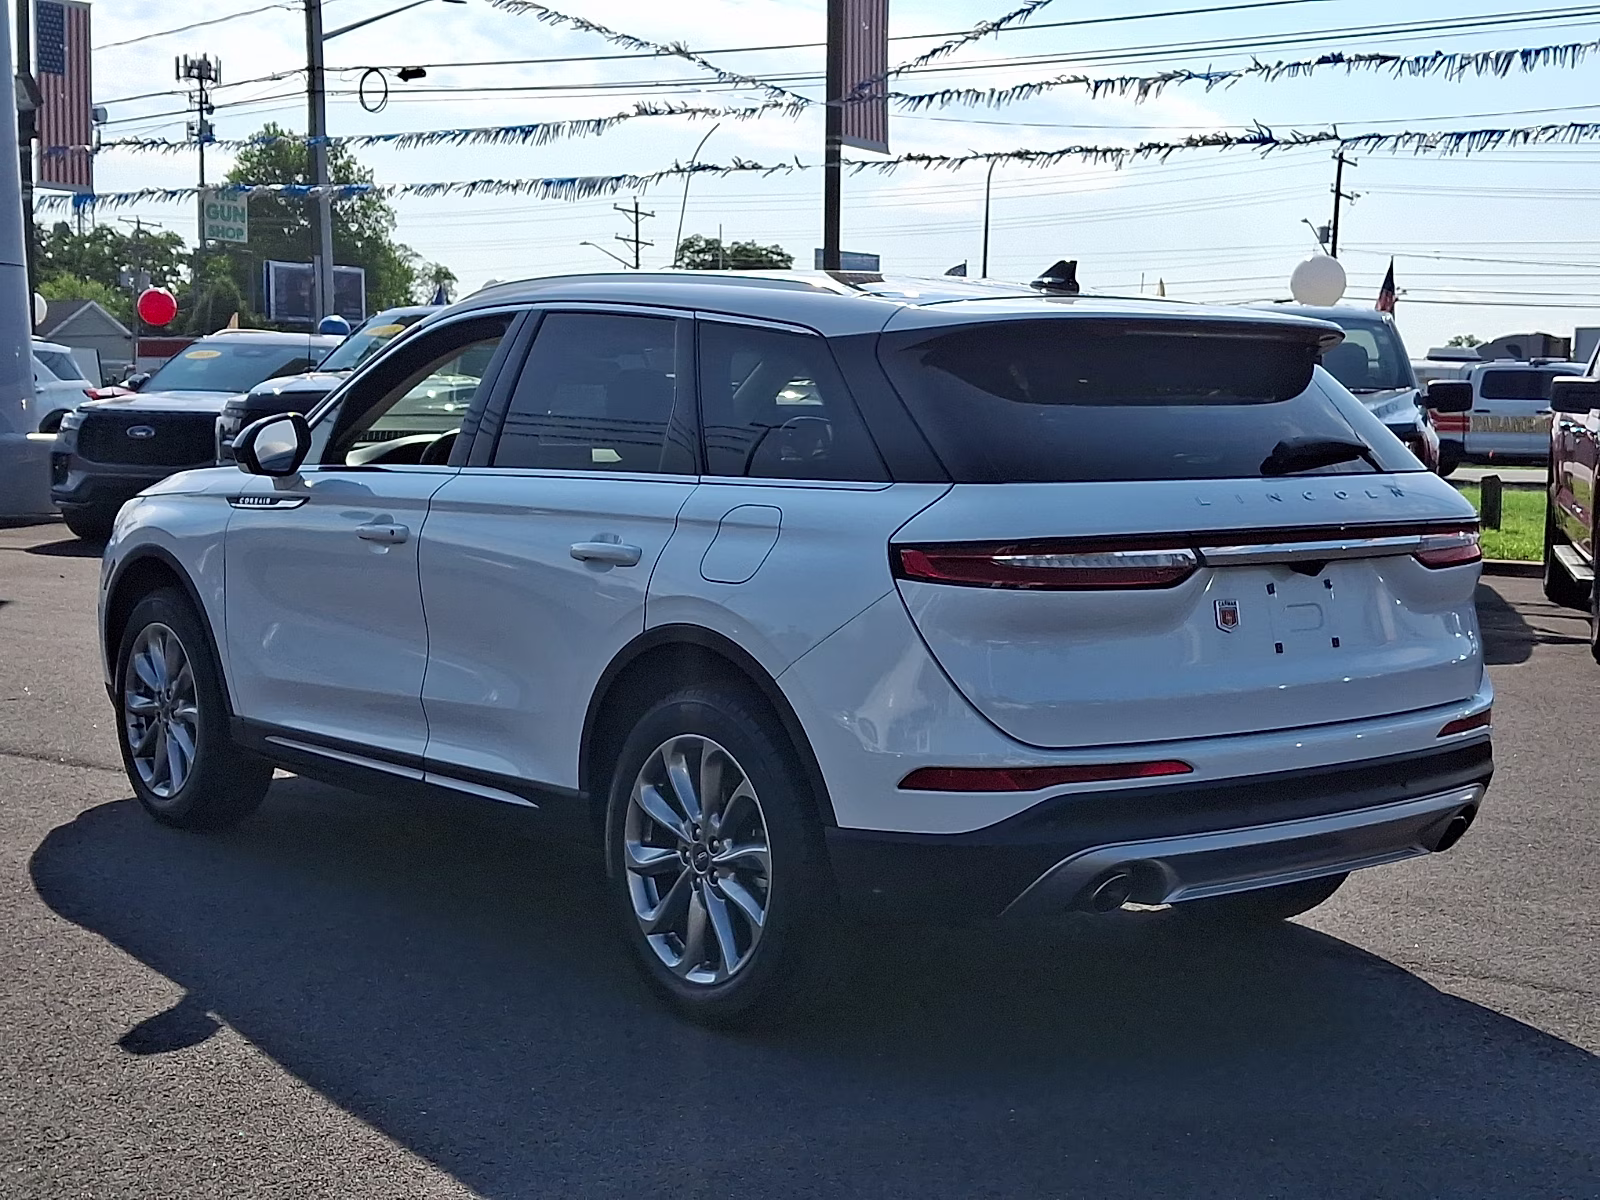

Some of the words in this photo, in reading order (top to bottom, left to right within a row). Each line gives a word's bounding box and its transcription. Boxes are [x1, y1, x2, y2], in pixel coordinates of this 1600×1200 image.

[206, 203, 246, 223] GUN
[208, 225, 244, 239] SHOP
[1195, 487, 1405, 506] LINCOLN
